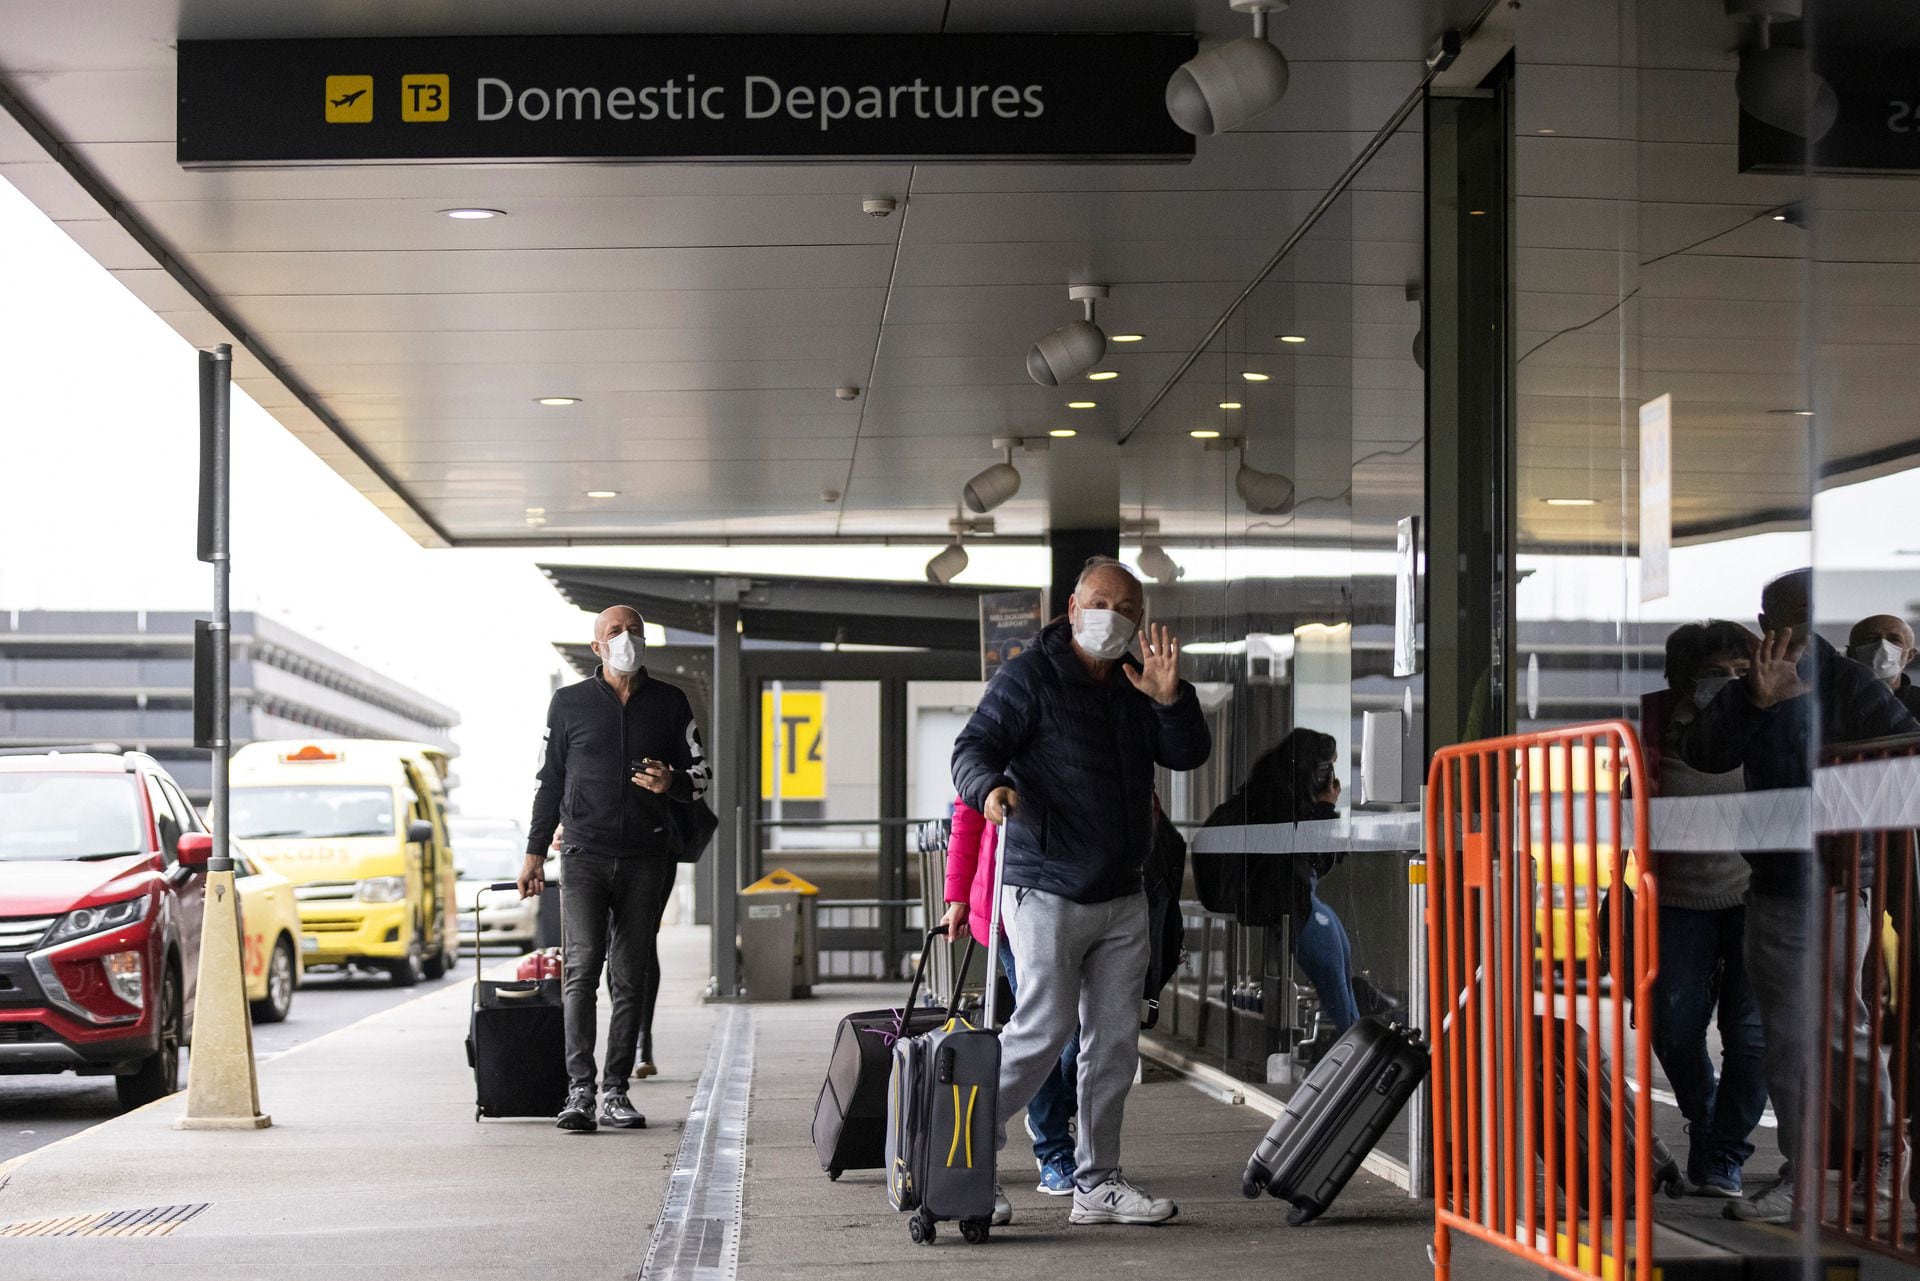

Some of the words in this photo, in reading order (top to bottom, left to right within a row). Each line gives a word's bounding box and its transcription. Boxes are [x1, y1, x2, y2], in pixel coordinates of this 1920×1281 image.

[408, 84, 442, 112] T3
[477, 75, 724, 121] Domestic
[745, 76, 1044, 131] Departures
